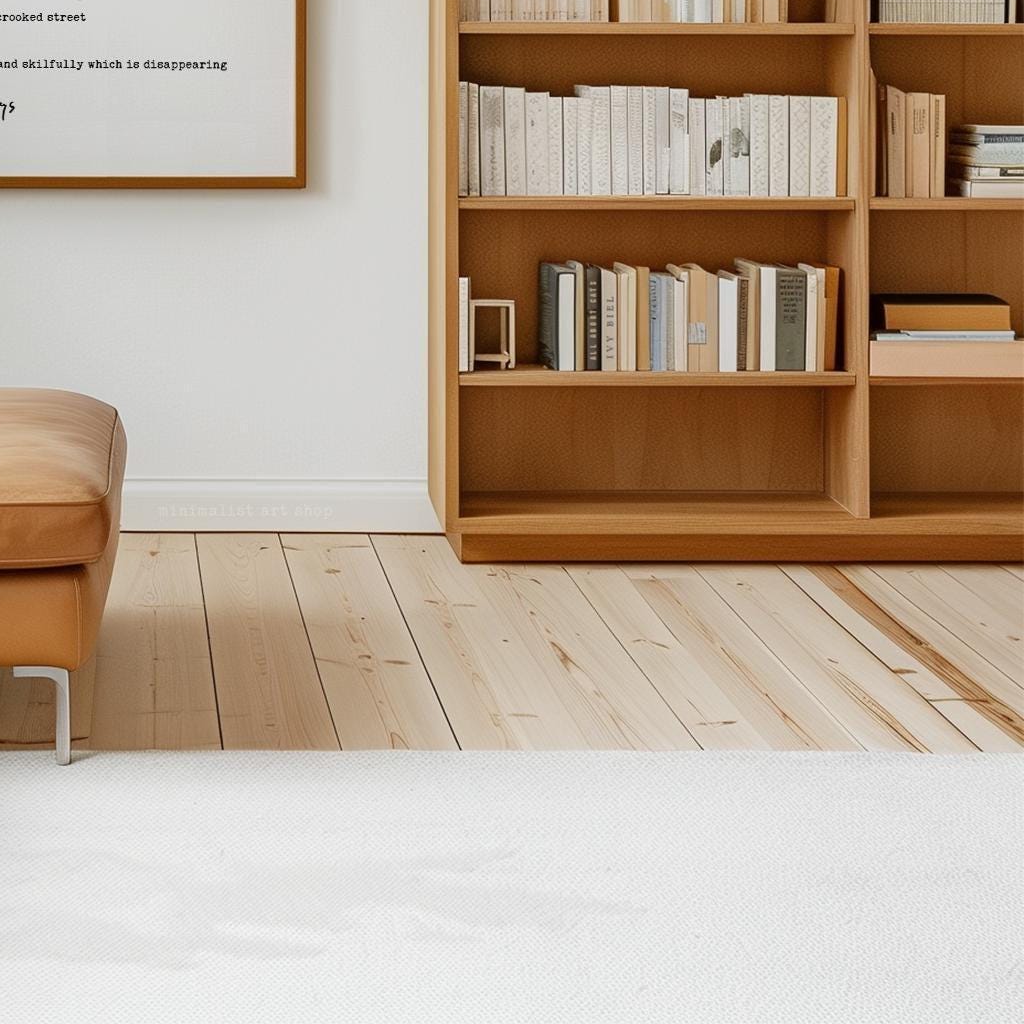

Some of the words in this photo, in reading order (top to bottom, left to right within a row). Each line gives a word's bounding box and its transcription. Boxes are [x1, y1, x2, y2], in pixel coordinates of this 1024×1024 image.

[46, 12, 87, 22] street
[21, 58, 85, 71] skilfully
[87, 59, 123, 70] which
[126, 59, 140, 70] is
[142, 59, 228, 72] disappearing
[589, 280, 597, 304] CATS
[606, 296, 615, 327] BIEL
[589, 344, 597, 361] ALL
[606, 335, 614, 360] IVY
